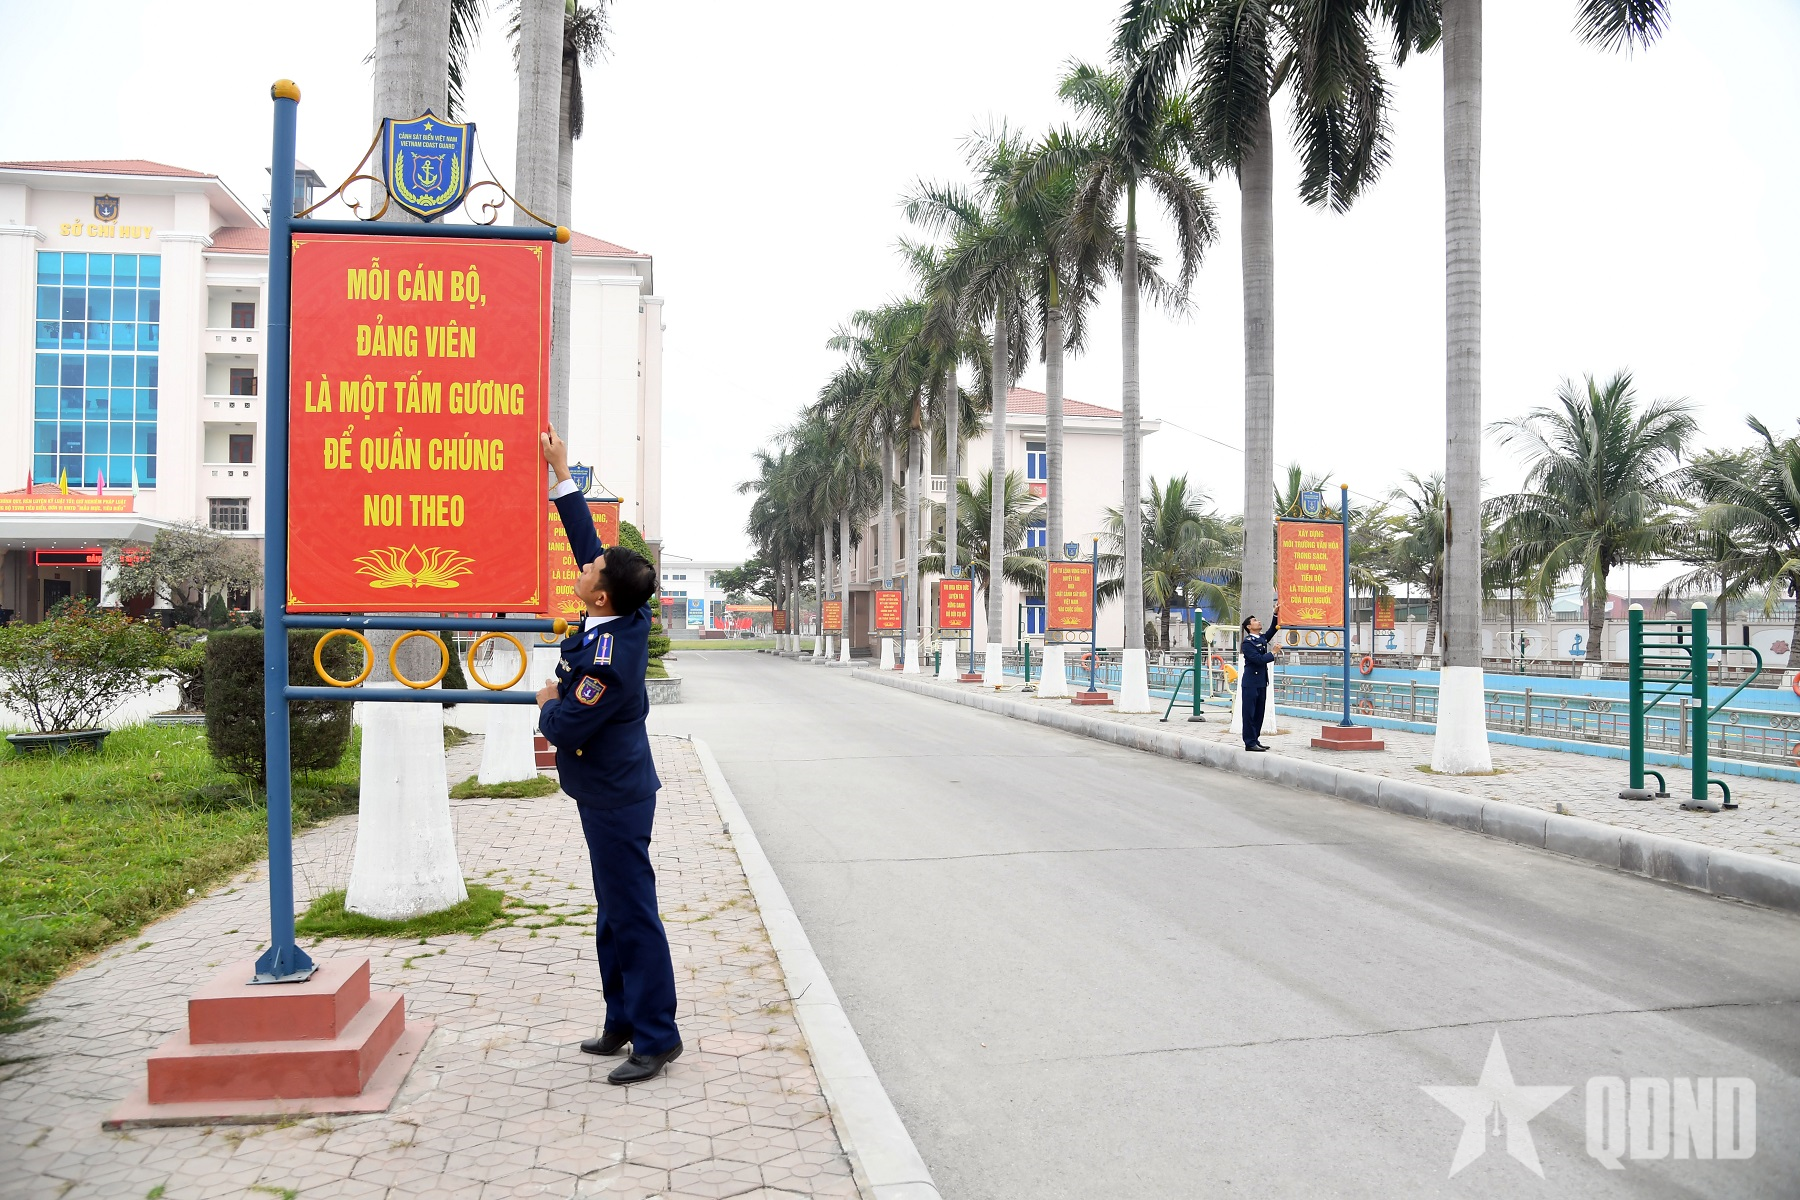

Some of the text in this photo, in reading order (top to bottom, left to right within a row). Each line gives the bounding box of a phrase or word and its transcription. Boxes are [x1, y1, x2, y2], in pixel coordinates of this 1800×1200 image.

[60, 219, 152, 239] SỞ CHỈ HUY
[347, 256, 486, 309] MỖI CÁN BỘ,
[356, 314, 476, 358] ĐẢNG VIÊN
[305, 370, 524, 420] LÀ MỘT TẤM GƯƠNG
[324, 424, 504, 474] ĐỂ QUẦN CHÚNG
[364, 494, 464, 527] NOI THEO
[562, 555, 572, 565] CÓ
